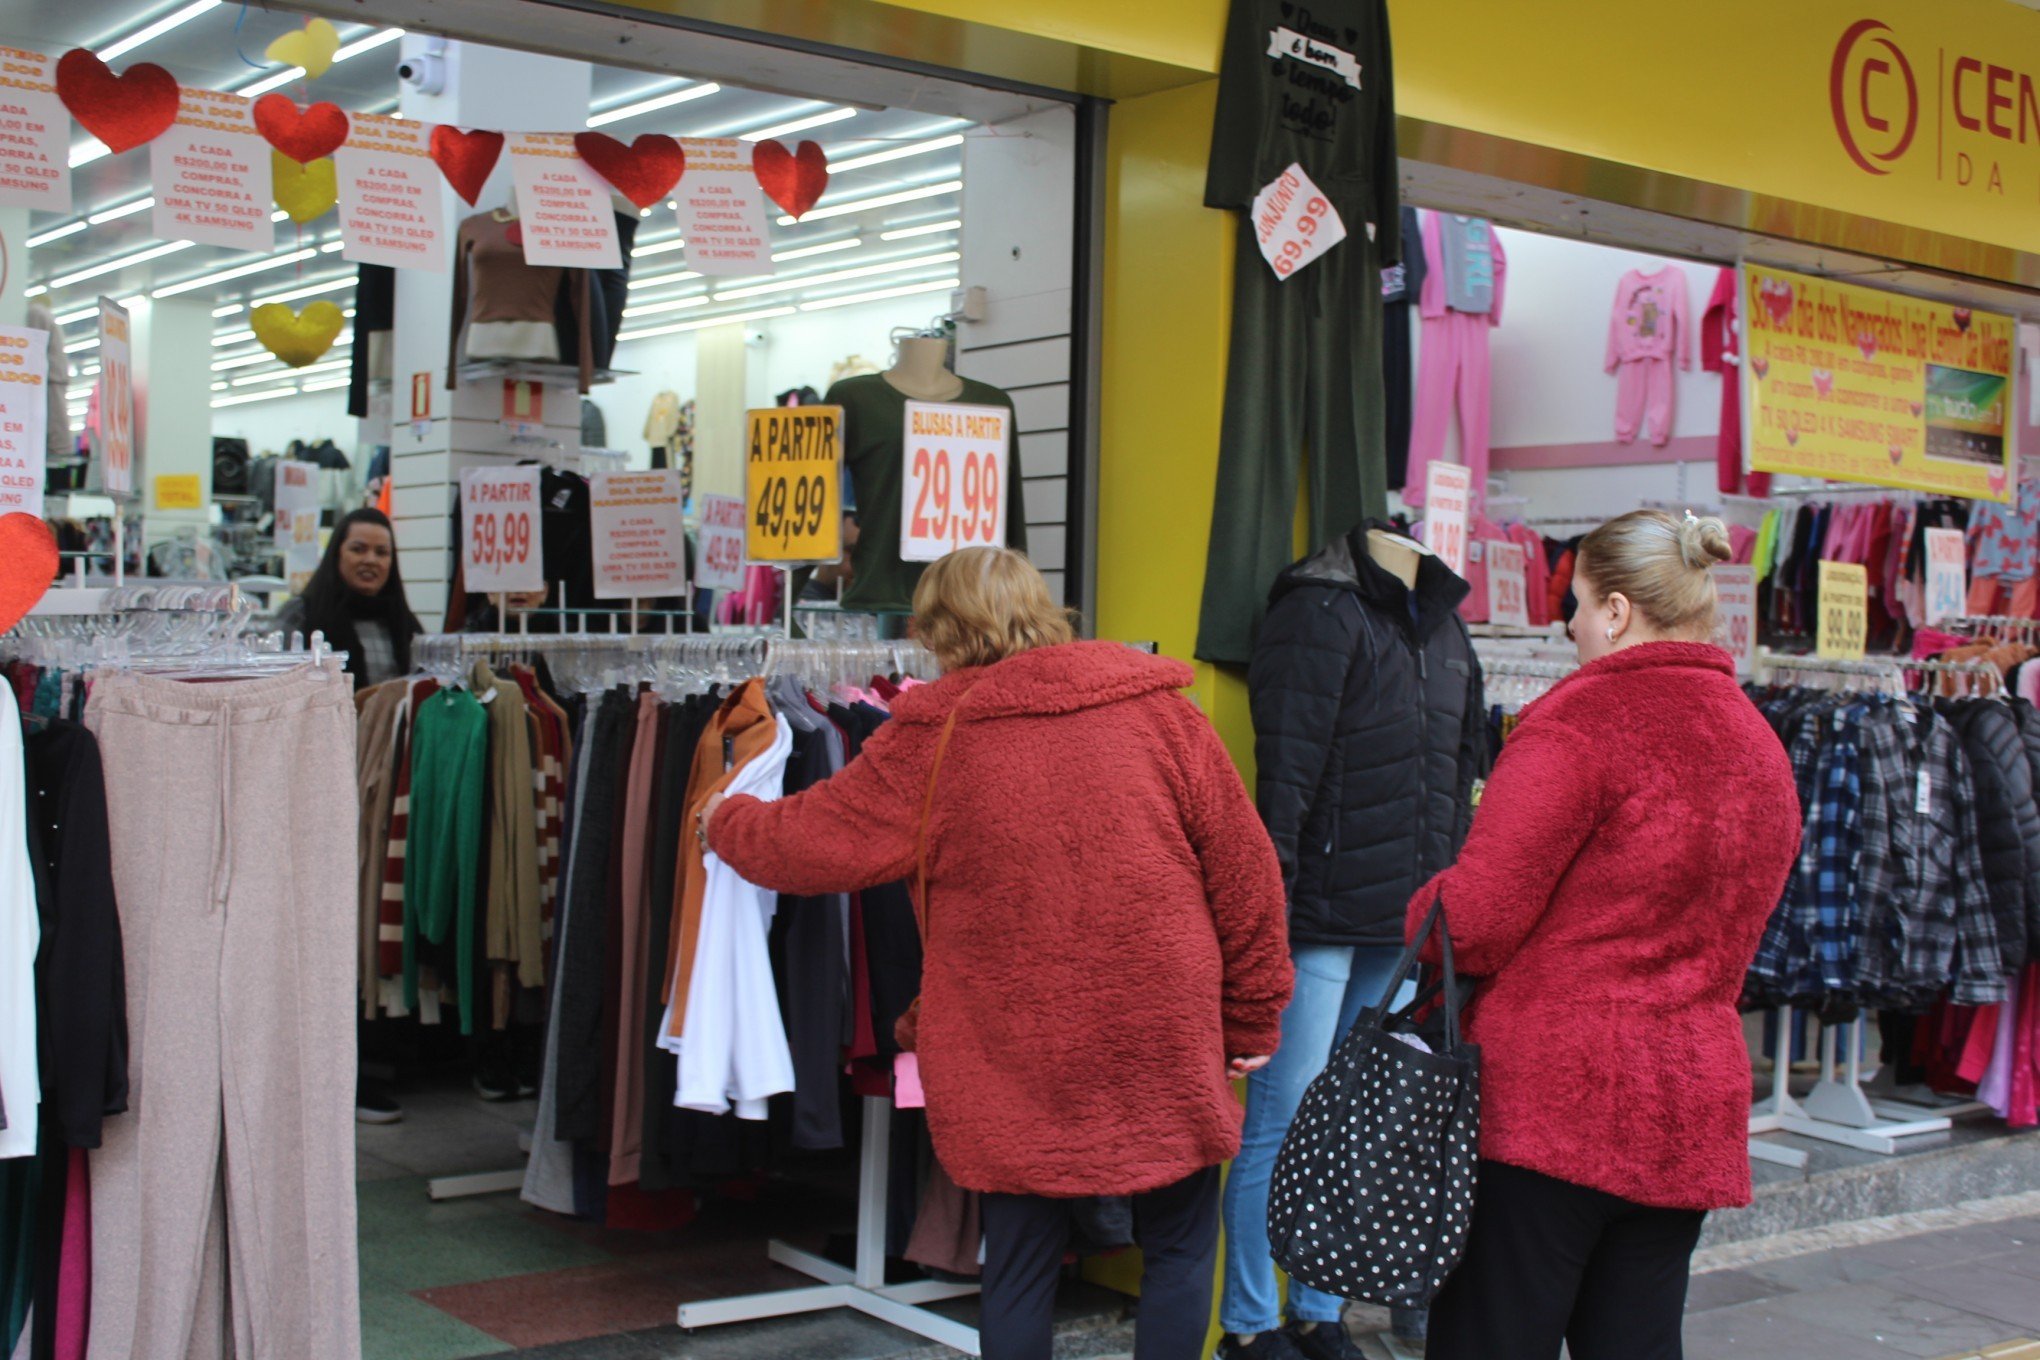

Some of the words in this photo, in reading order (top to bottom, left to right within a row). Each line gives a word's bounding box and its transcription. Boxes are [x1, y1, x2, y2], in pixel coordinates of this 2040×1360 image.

[3, 61, 43, 77] DOS
[208, 106, 244, 120] DOS
[25, 122, 46, 133] EM
[354, 126, 382, 137] DIA
[386, 130, 418, 142] DOS
[39, 153, 48, 162] A
[188, 144, 197, 153] A
[200, 145, 233, 157] CADA
[5, 163, 20, 173] 50
[24, 166, 60, 178] QLED
[231, 163, 249, 173] EM
[378, 168, 408, 179] CADA
[1957, 151, 2004, 196] DA
[181, 170, 244, 187] COMPRAS,
[551, 174, 577, 182] CADA
[173, 183, 240, 200] CONCORRA
[244, 192, 253, 201] A
[407, 186, 421, 195] EM
[164, 197, 192, 208] UMA
[195, 200, 211, 210] TV
[214, 202, 229, 213] 50
[231, 205, 263, 217] QLED
[362, 193, 417, 209] COMPRAS,
[175, 213, 191, 223] 4K
[195, 214, 254, 231] SAMSUNG
[356, 206, 414, 222] CONCORRA
[418, 215, 425, 223] A
[349, 220, 371, 230] UMA
[376, 223, 388, 233] TV
[407, 228, 434, 238] QLED
[1272, 196, 1328, 275] 69,99
[375, 237, 427, 252] SAMSUNG
[555, 240, 602, 250] SAMSUNG
[4, 422, 23, 432] EM
[912, 411, 953, 436] BLUSAS
[956, 415, 963, 438] A
[966, 415, 1002, 440] PARTIR
[751, 418, 762, 462] A
[768, 416, 835, 461] PARTIR
[16, 459, 25, 468] A
[2, 475, 34, 487] QLED
[470, 484, 477, 502] A
[481, 482, 531, 502] PARTIR
[910, 447, 999, 552] 29,99
[756, 475, 825, 551] 49,99
[473, 512, 530, 575] 59,99
